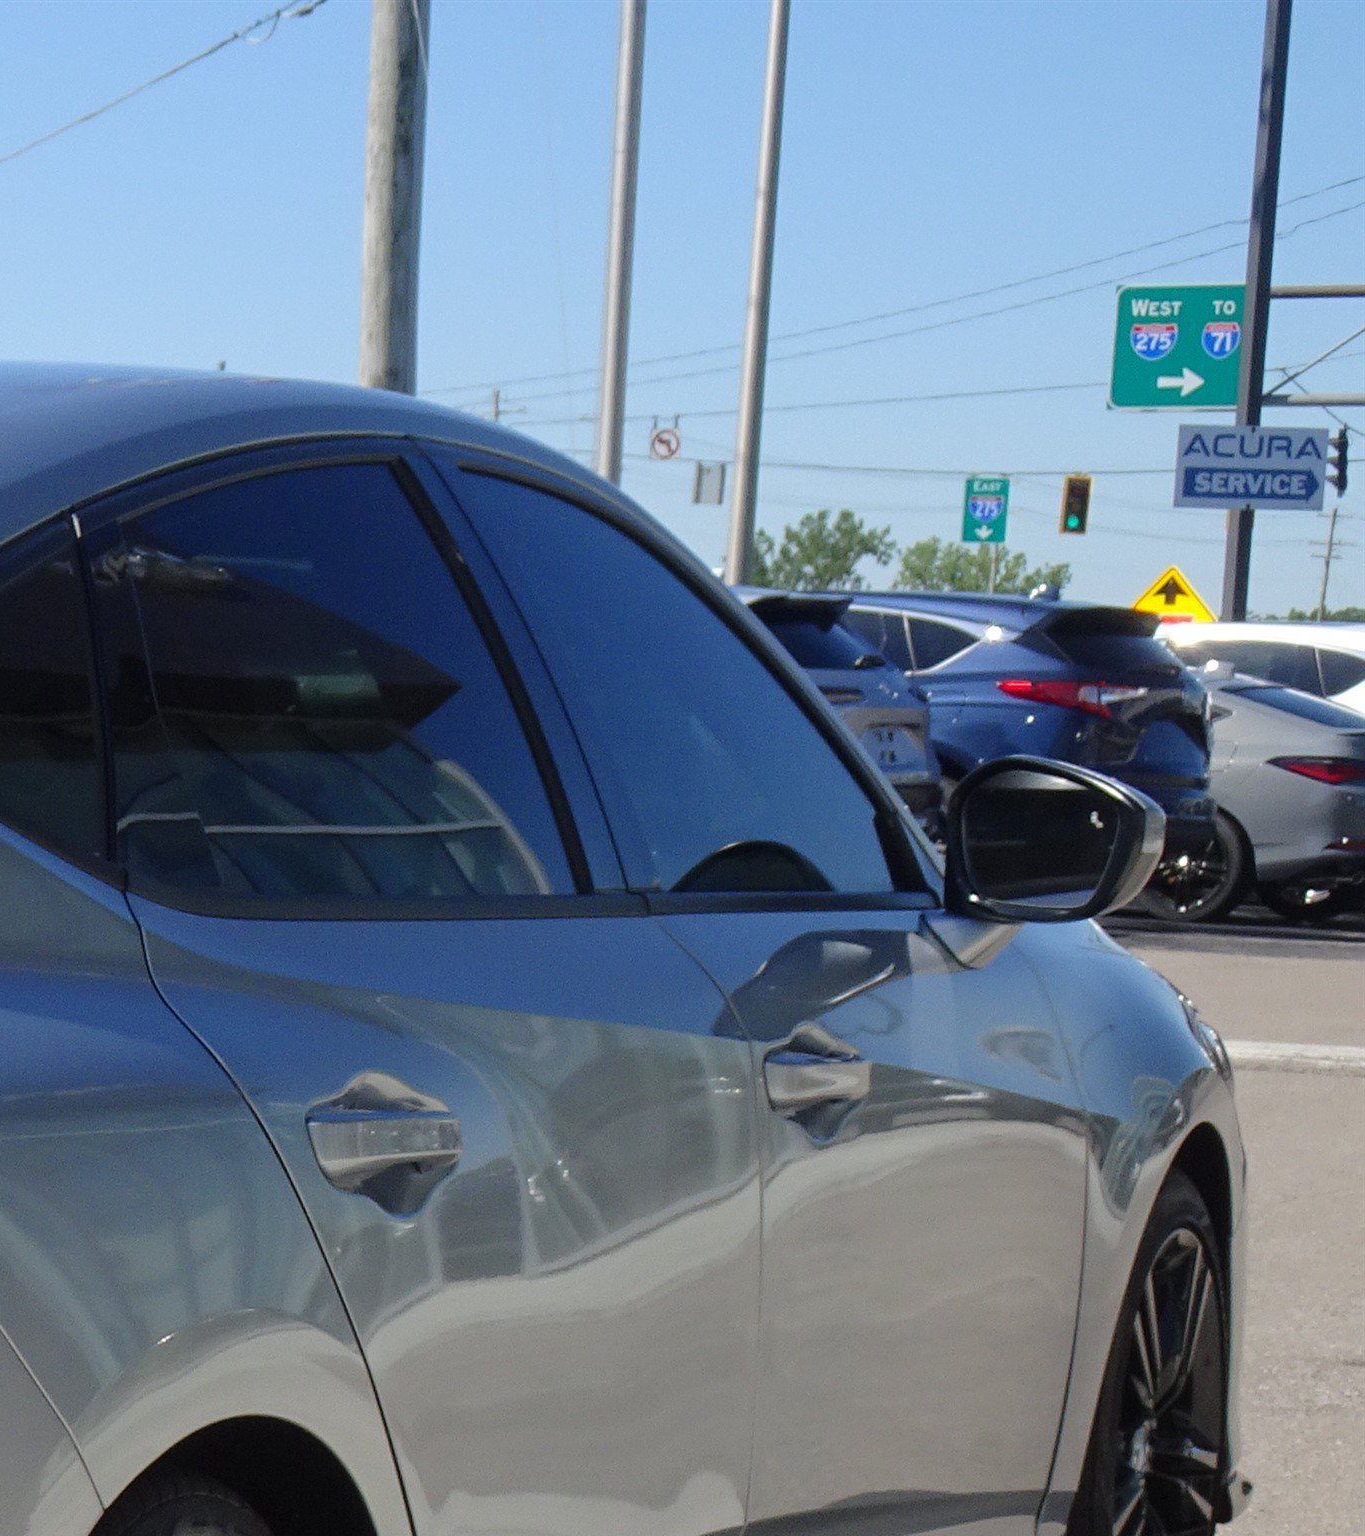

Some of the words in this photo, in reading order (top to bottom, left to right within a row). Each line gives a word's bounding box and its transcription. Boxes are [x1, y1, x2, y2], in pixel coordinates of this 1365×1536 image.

[1131, 299, 1182, 316] WEST
[1213, 300, 1236, 315] TO
[1135, 333, 1171, 351] 275
[1212, 332, 1232, 351] 71
[1183, 433, 1322, 459] ACURA
[1194, 473, 1308, 495] SERVICE
[975, 501, 997, 517] 275
